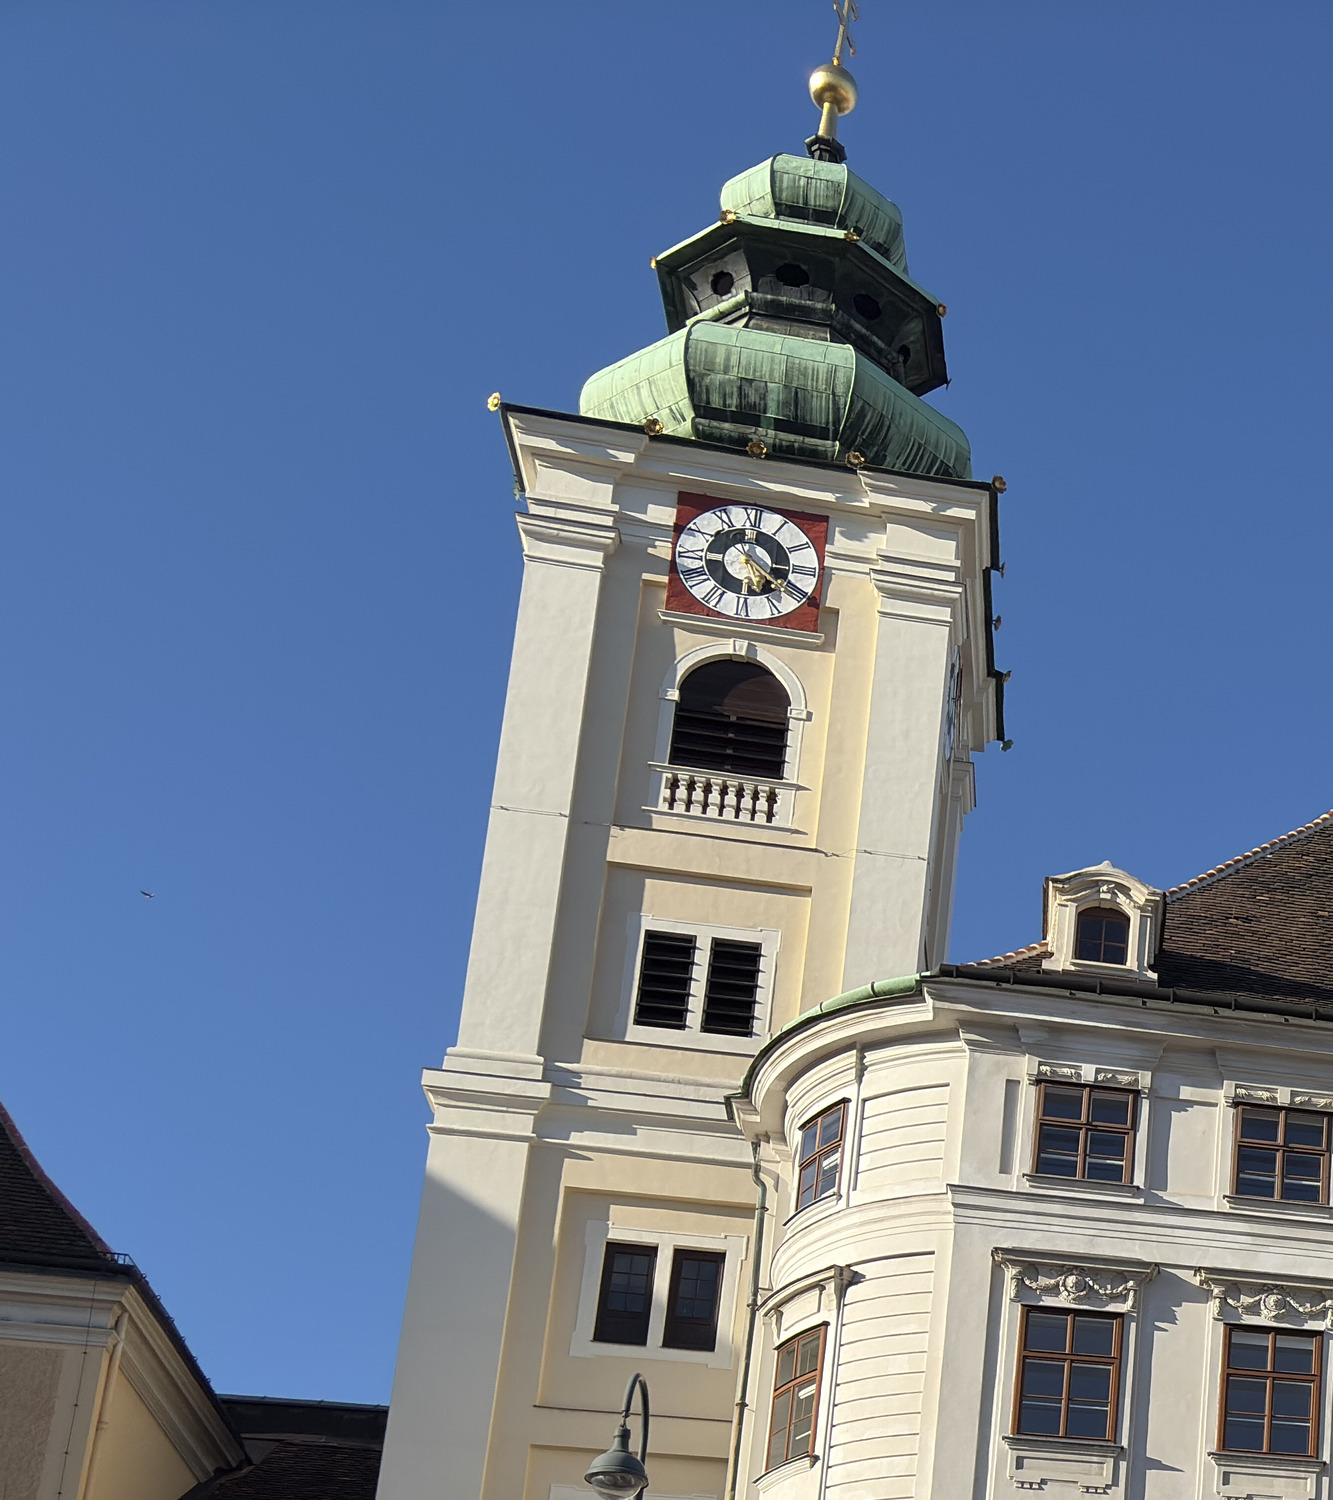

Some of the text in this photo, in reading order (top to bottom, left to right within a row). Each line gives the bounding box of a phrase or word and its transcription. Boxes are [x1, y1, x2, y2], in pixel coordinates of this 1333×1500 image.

[742, 507, 764, 529] XII
[678, 544, 704, 561] IX
[786, 541, 812, 554] II
[792, 564, 816, 578] III
